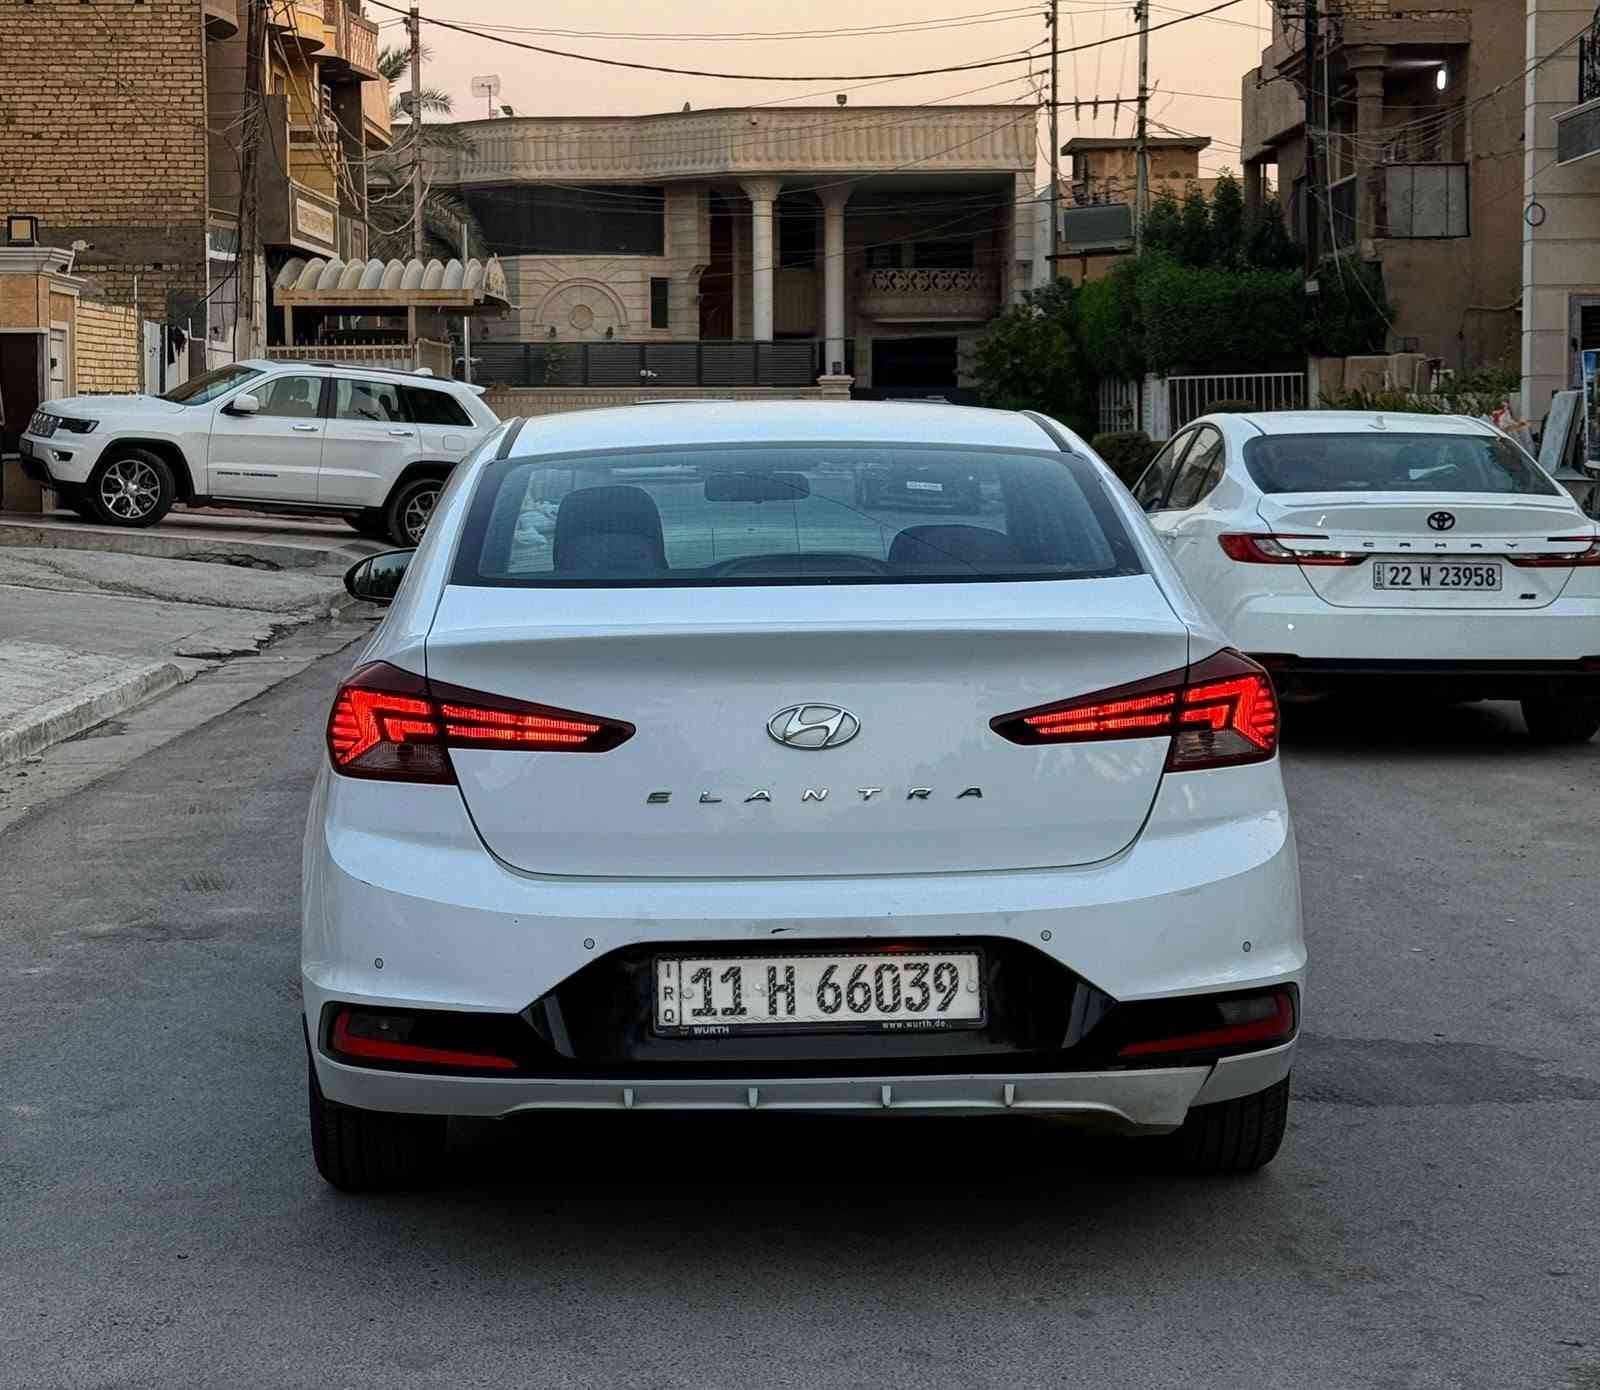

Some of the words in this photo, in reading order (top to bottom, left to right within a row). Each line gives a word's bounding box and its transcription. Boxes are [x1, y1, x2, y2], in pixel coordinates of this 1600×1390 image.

[1389, 566, 1412, 586] 22
[1420, 566, 1432, 586] W
[1439, 566, 1497, 587] 23958
[646, 786, 984, 805] ELANTRA
[663, 963, 675, 1023] IRQ
[690, 966, 748, 1017] 11
[767, 965, 796, 1016] H
[816, 961, 960, 1015] 66039
